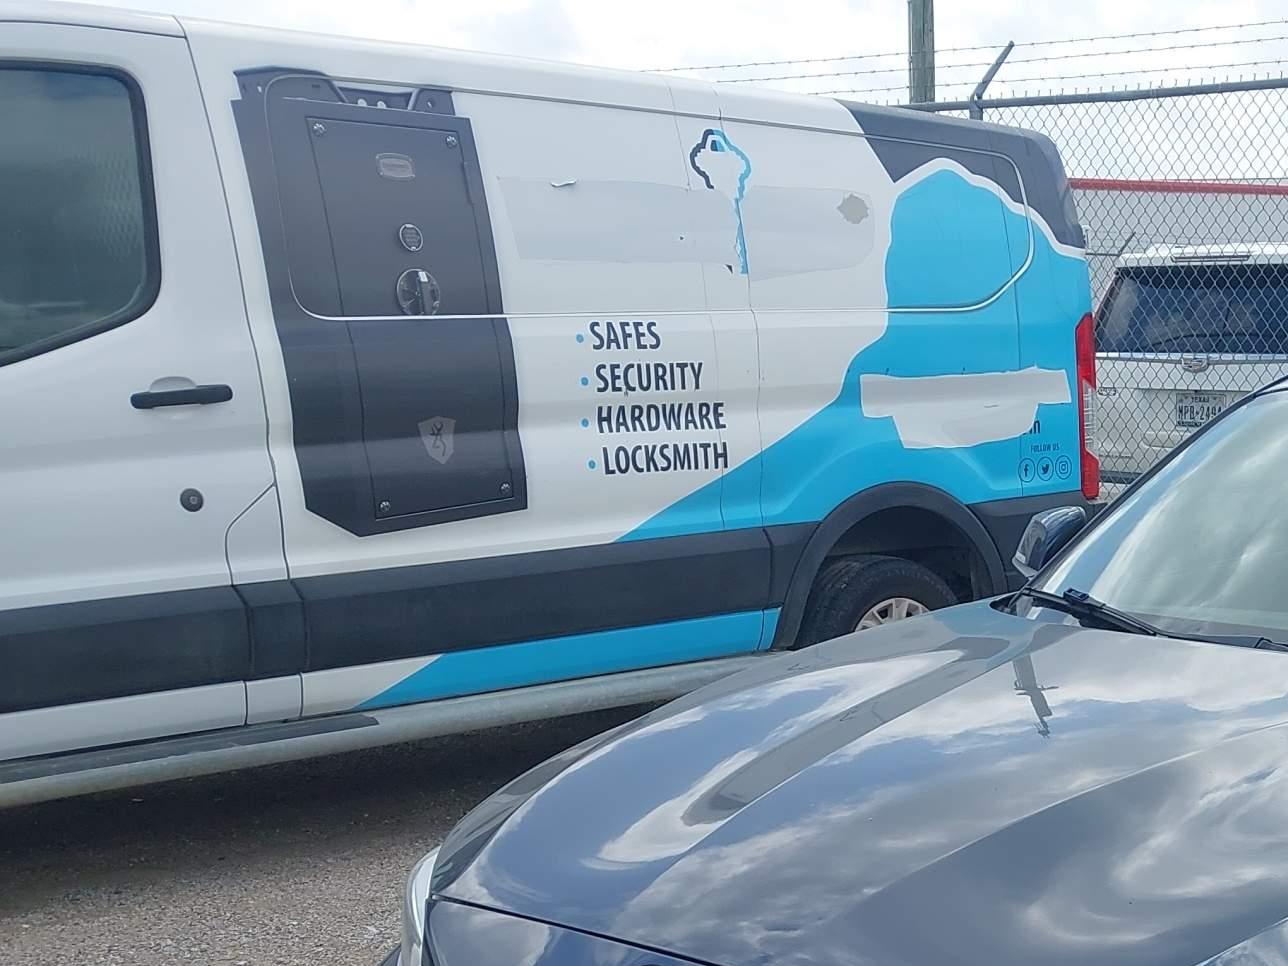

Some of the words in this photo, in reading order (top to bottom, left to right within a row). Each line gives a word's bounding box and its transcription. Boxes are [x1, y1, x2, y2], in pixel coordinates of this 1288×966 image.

[589, 321, 661, 350] SAFES
[595, 362, 703, 393] SECURITY
[597, 402, 727, 434] HARDWARE
[602, 441, 729, 475] LOCKSMITH
[1031, 443, 1051, 453] FOLLOW
[1053, 442, 1060, 451] US
